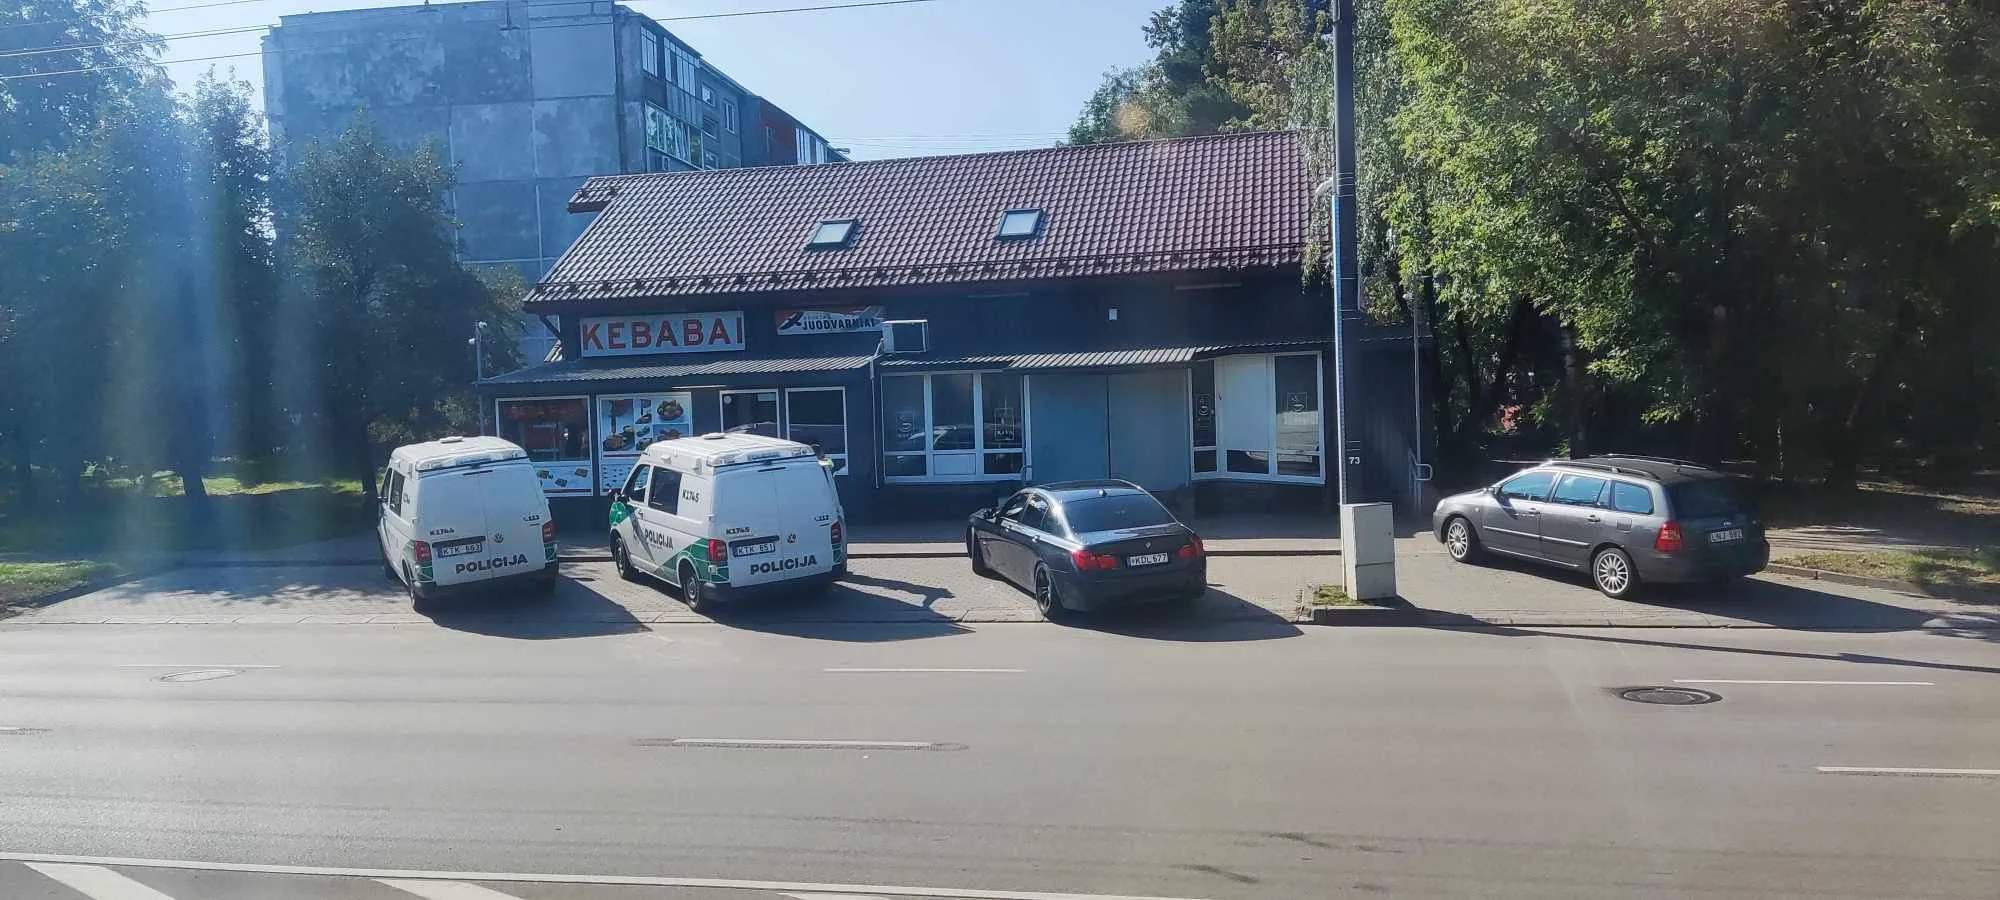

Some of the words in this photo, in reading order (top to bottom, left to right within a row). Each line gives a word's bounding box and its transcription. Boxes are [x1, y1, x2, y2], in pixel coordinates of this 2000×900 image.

[582, 316, 743, 351] KEBABAI
[1348, 456, 1361, 465] 73
[644, 528, 674, 550] POLICIJA
[455, 553, 529, 574] POLICIJA
[750, 555, 818, 575] POLICIJA
